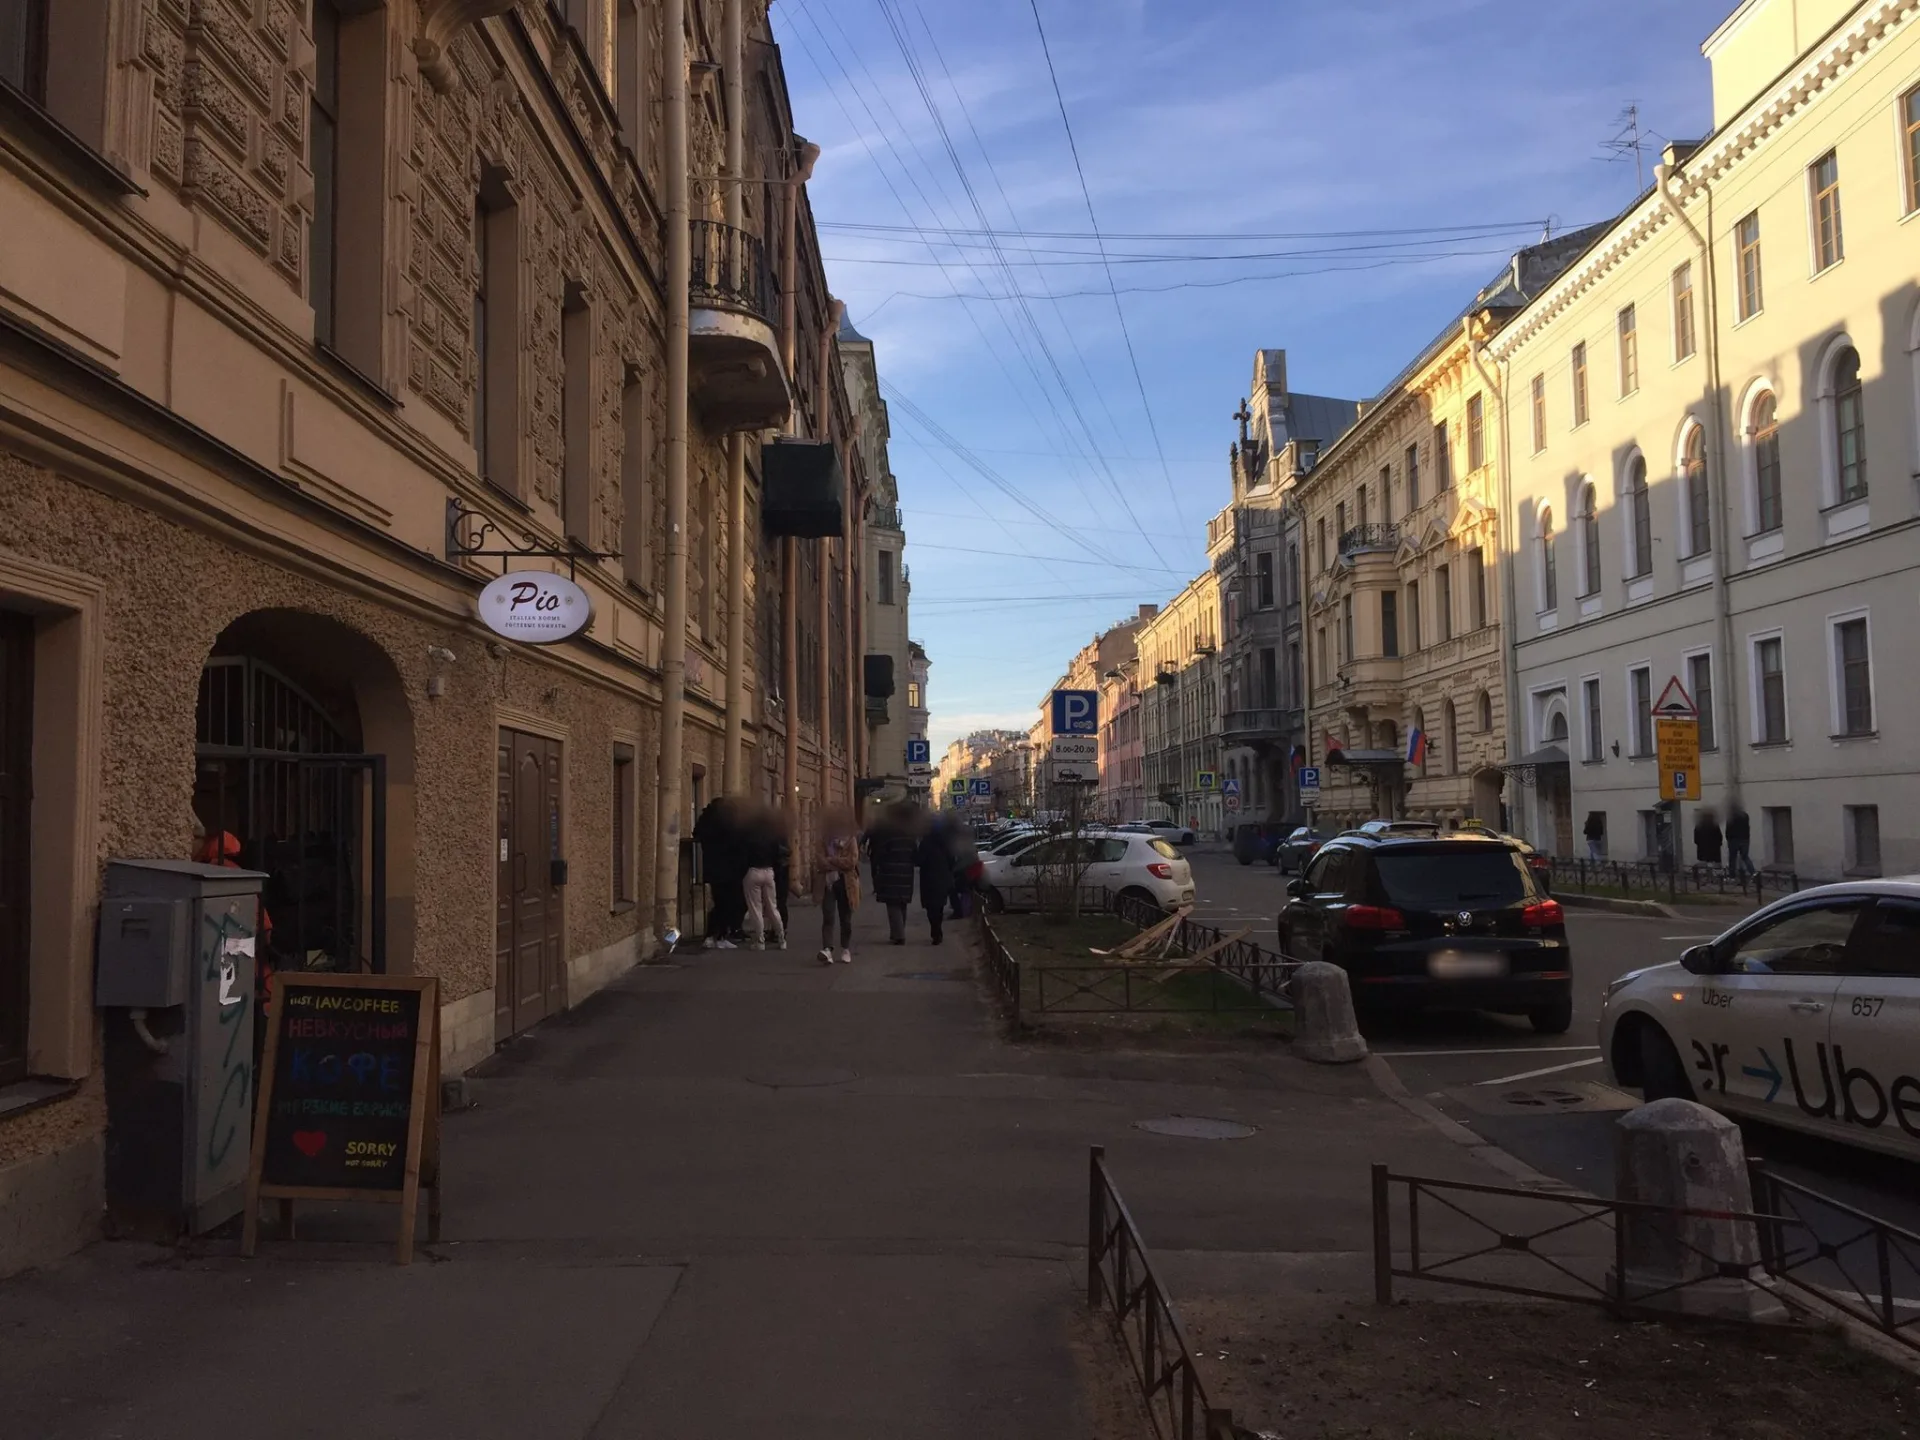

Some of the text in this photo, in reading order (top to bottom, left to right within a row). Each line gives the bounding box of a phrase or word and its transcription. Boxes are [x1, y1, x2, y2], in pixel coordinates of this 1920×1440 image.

[510, 581, 560, 611] Pio
[1065, 695, 1090, 730] P
[914, 742, 926, 761] P
[1305, 770, 1316, 785] P
[1702, 988, 1734, 1008] Uber
[1851, 996, 1885, 1017] 657
[291, 1047, 402, 1092] КОФЕ
[344, 1141, 397, 1157] SORRY
